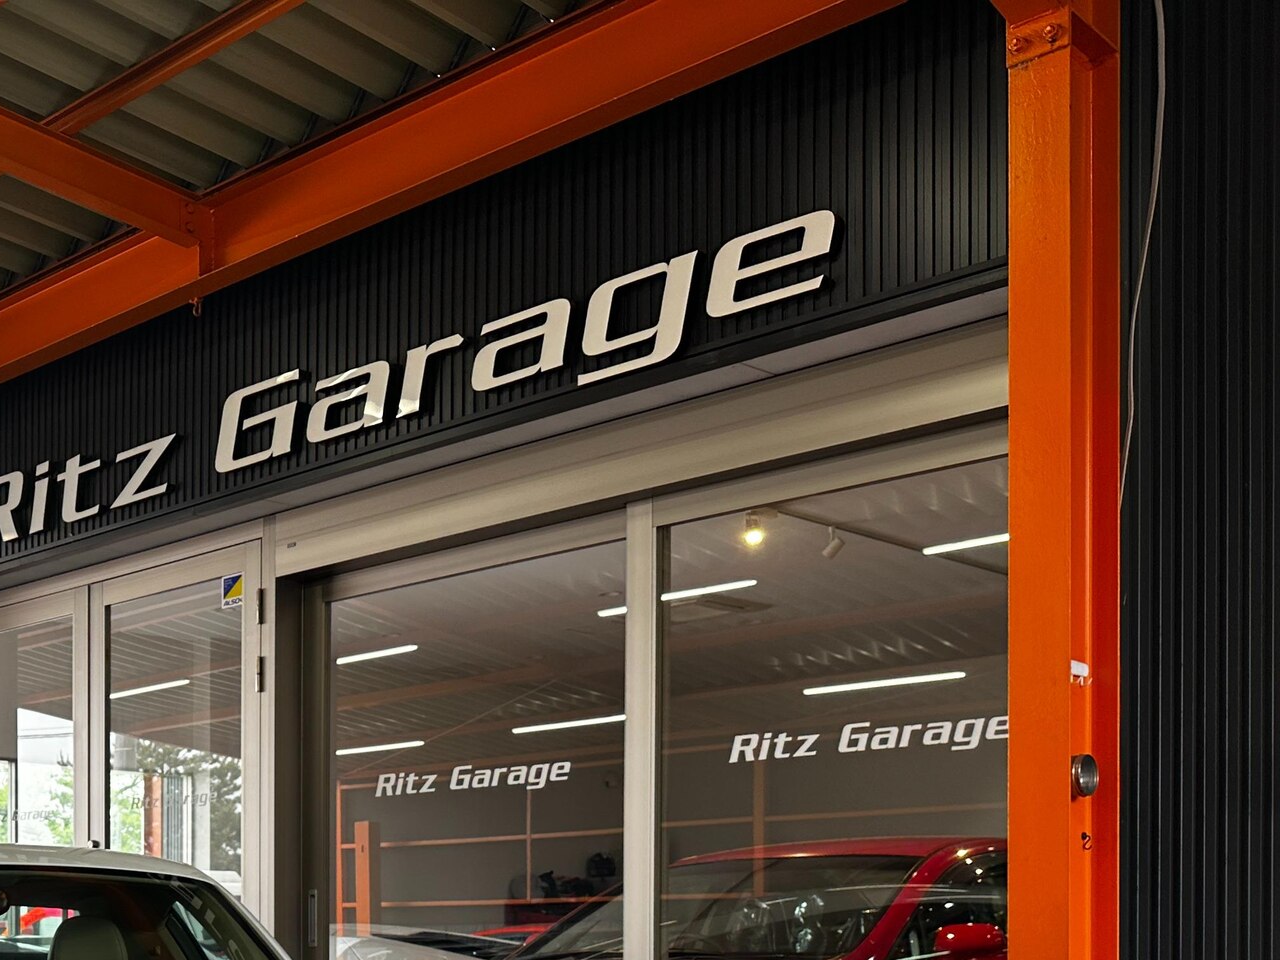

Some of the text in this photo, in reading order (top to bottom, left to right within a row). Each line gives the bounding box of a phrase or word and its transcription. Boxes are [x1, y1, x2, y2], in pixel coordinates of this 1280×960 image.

[215, 209, 836, 473] Garage
[728, 715, 1008, 764] Ritz Garage
[374, 761, 571, 797] Ritz Garage
